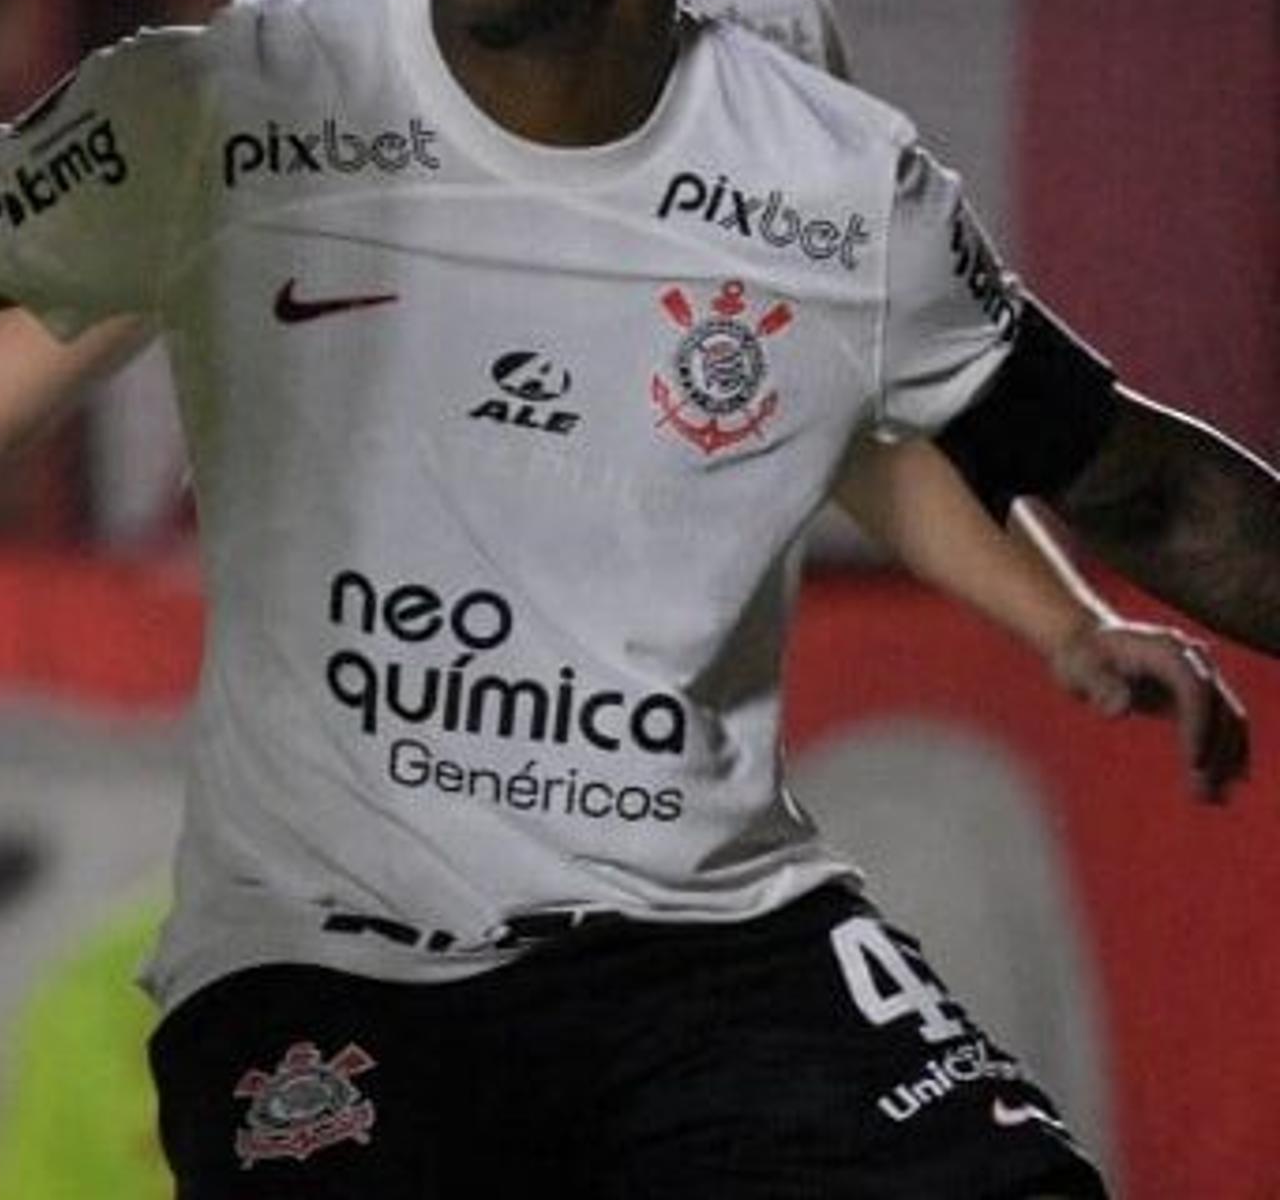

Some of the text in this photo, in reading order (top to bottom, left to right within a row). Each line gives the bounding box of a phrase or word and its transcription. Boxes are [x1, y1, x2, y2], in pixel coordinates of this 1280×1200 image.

[224, 117, 441, 188] pixbet
[655, 170, 871, 272] pixbet
[468, 399, 582, 436] ALE
[328, 568, 514, 651] neo
[325, 649, 687, 756] química
[388, 737, 686, 823] Genéricos
